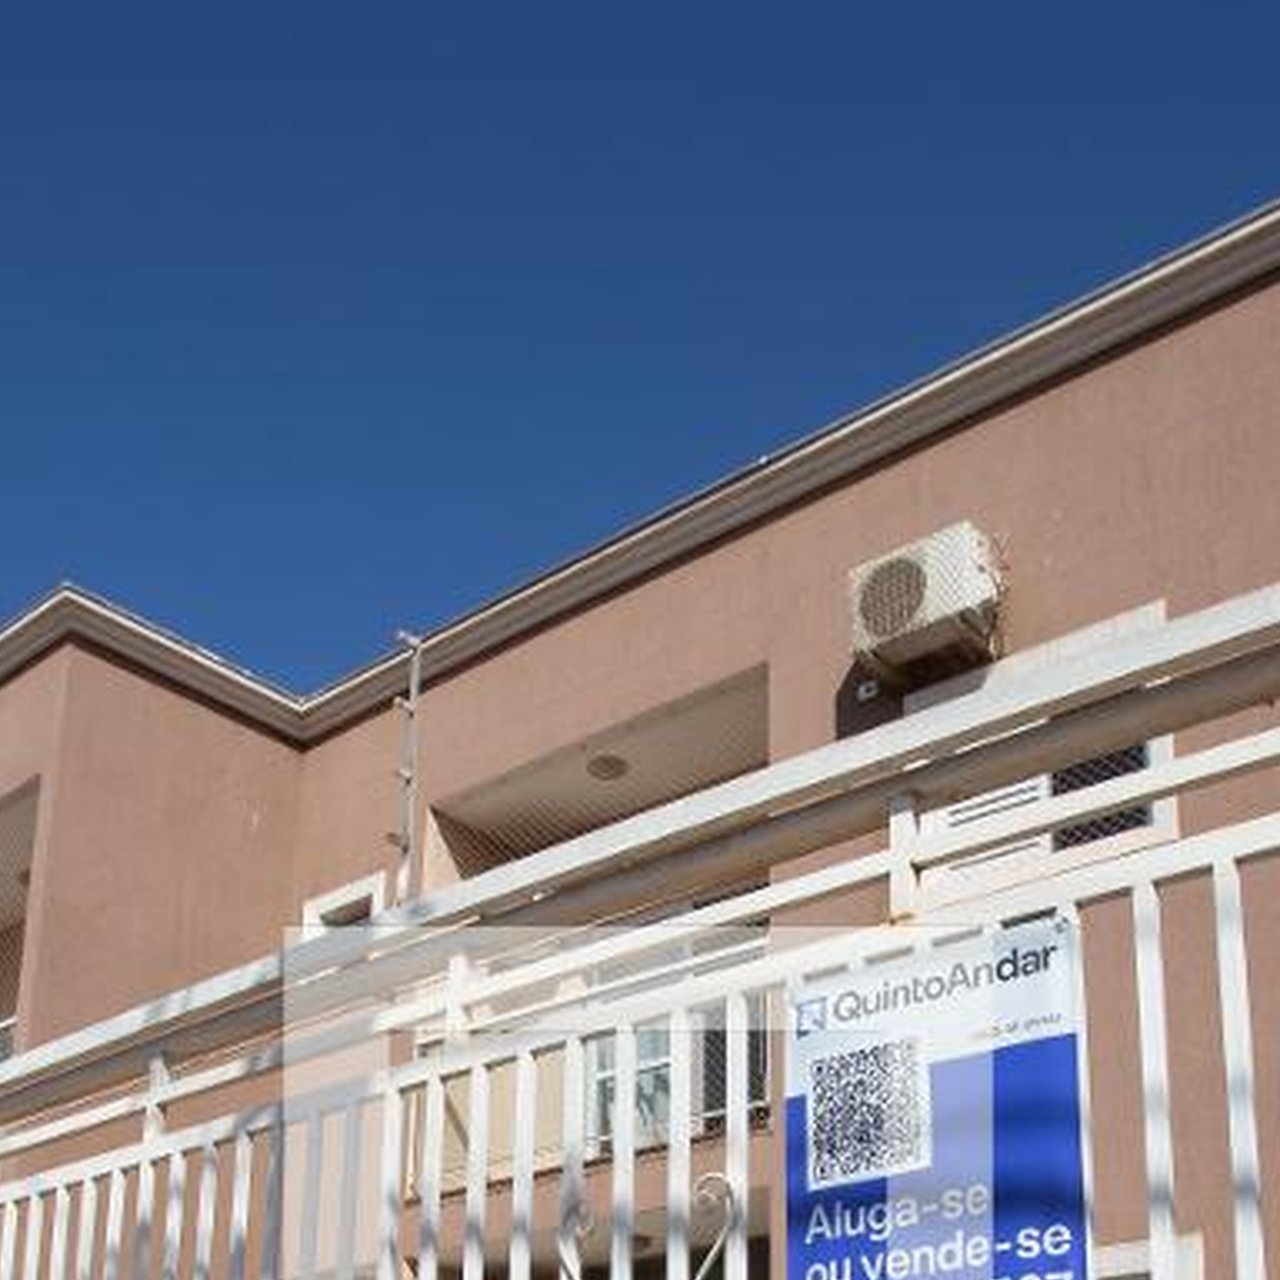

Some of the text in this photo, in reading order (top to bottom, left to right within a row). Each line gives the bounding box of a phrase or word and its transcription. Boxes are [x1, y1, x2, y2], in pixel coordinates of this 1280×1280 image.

[832, 943, 1058, 1025] QuintoAndar
[805, 1183, 990, 1245] Aluga-se
[860, 1222, 1073, 1279] vende-se
